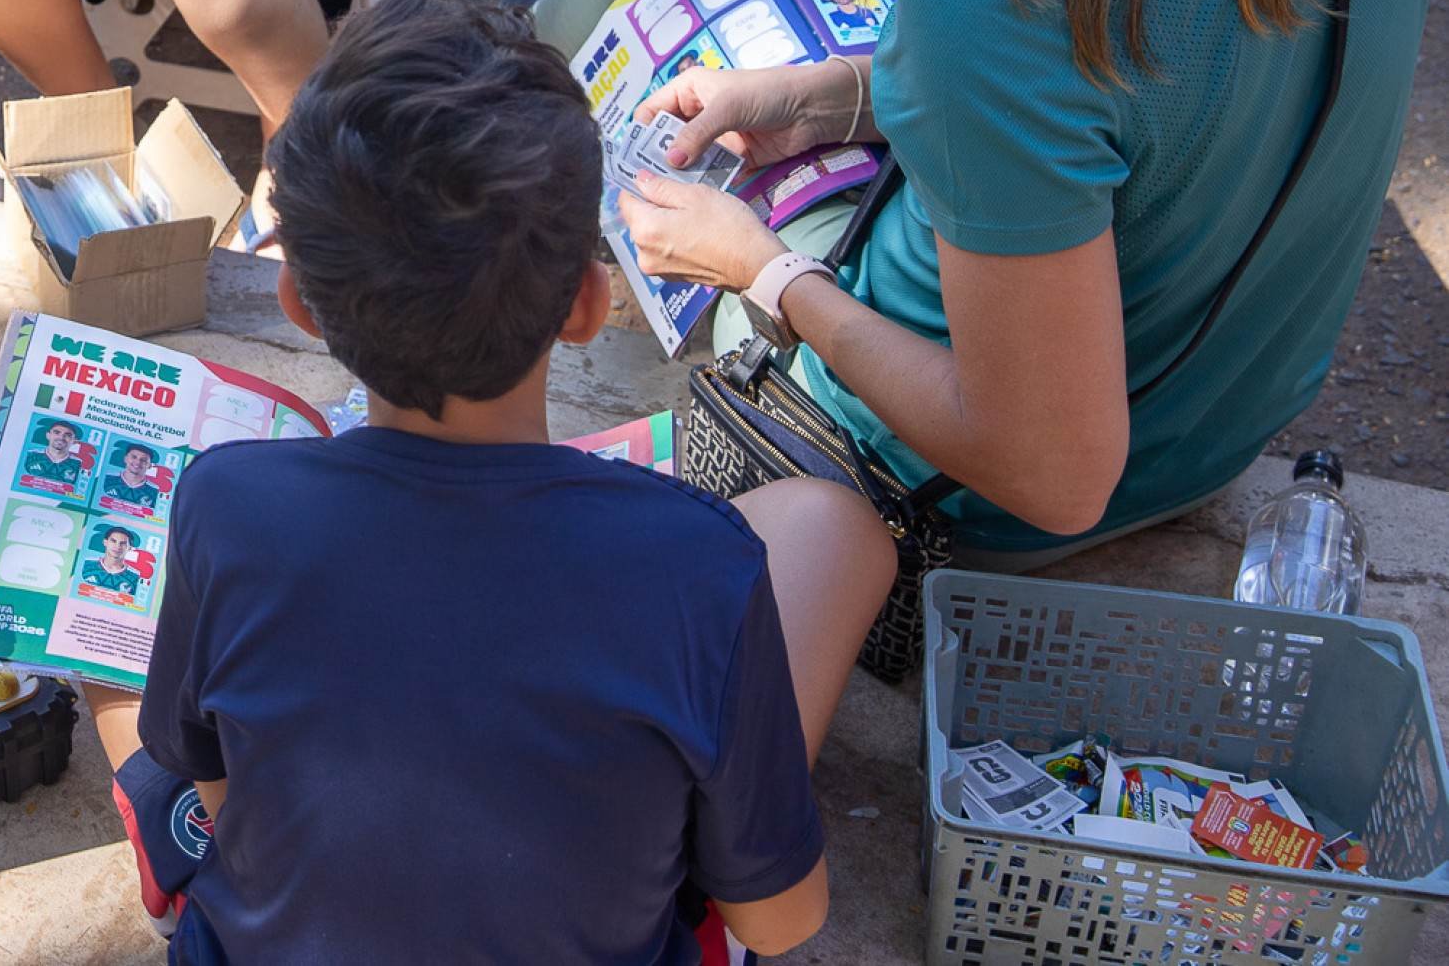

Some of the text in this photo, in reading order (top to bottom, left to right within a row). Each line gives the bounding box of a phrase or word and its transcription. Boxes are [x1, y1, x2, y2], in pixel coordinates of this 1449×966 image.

[591, 47, 630, 109] AÇAO
[51, 334, 106, 363] WE
[43, 355, 176, 408] MEXICO
[86, 404, 137, 425] Mexicana
[137, 416, 151, 428] de
[88, 396, 147, 417] Federación
[9, 623, 47, 637] 2026
